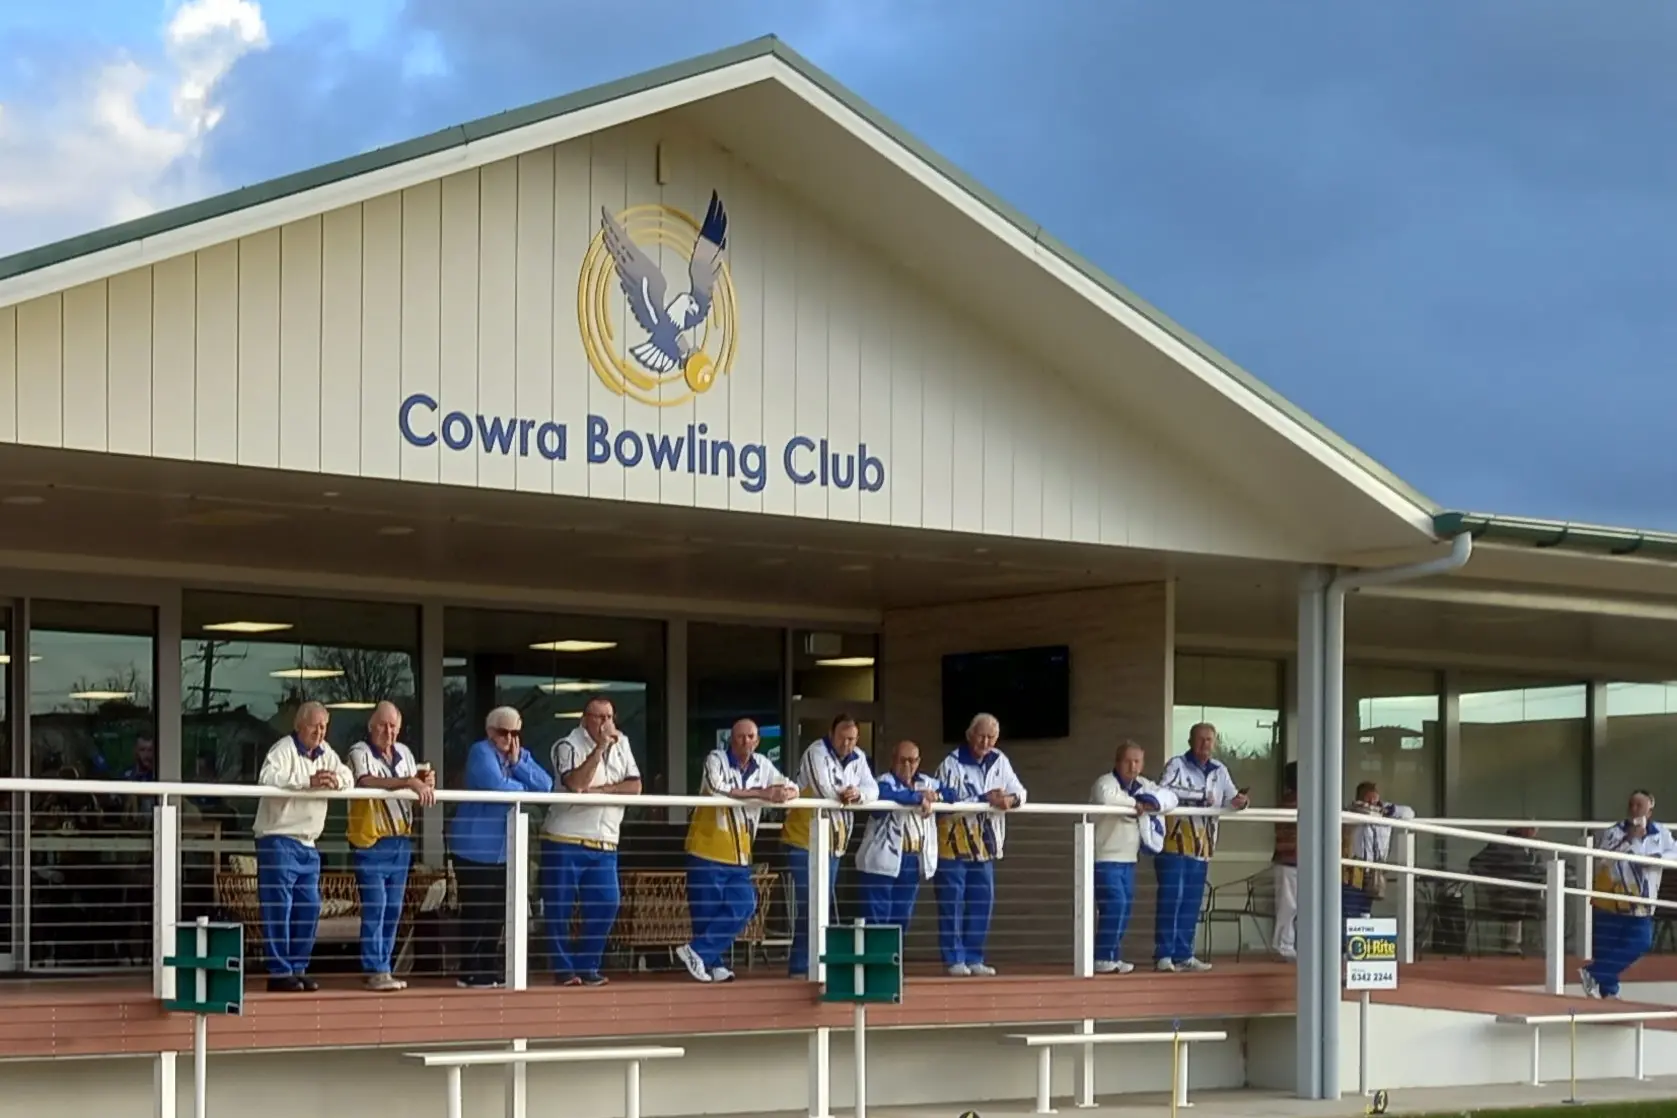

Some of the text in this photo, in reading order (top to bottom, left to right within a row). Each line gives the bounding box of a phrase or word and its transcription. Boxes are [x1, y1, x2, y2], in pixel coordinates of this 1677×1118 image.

[399, 393, 885, 493] Cowra Bowling Club
[1351, 972, 1393, 981] 6342 2244
